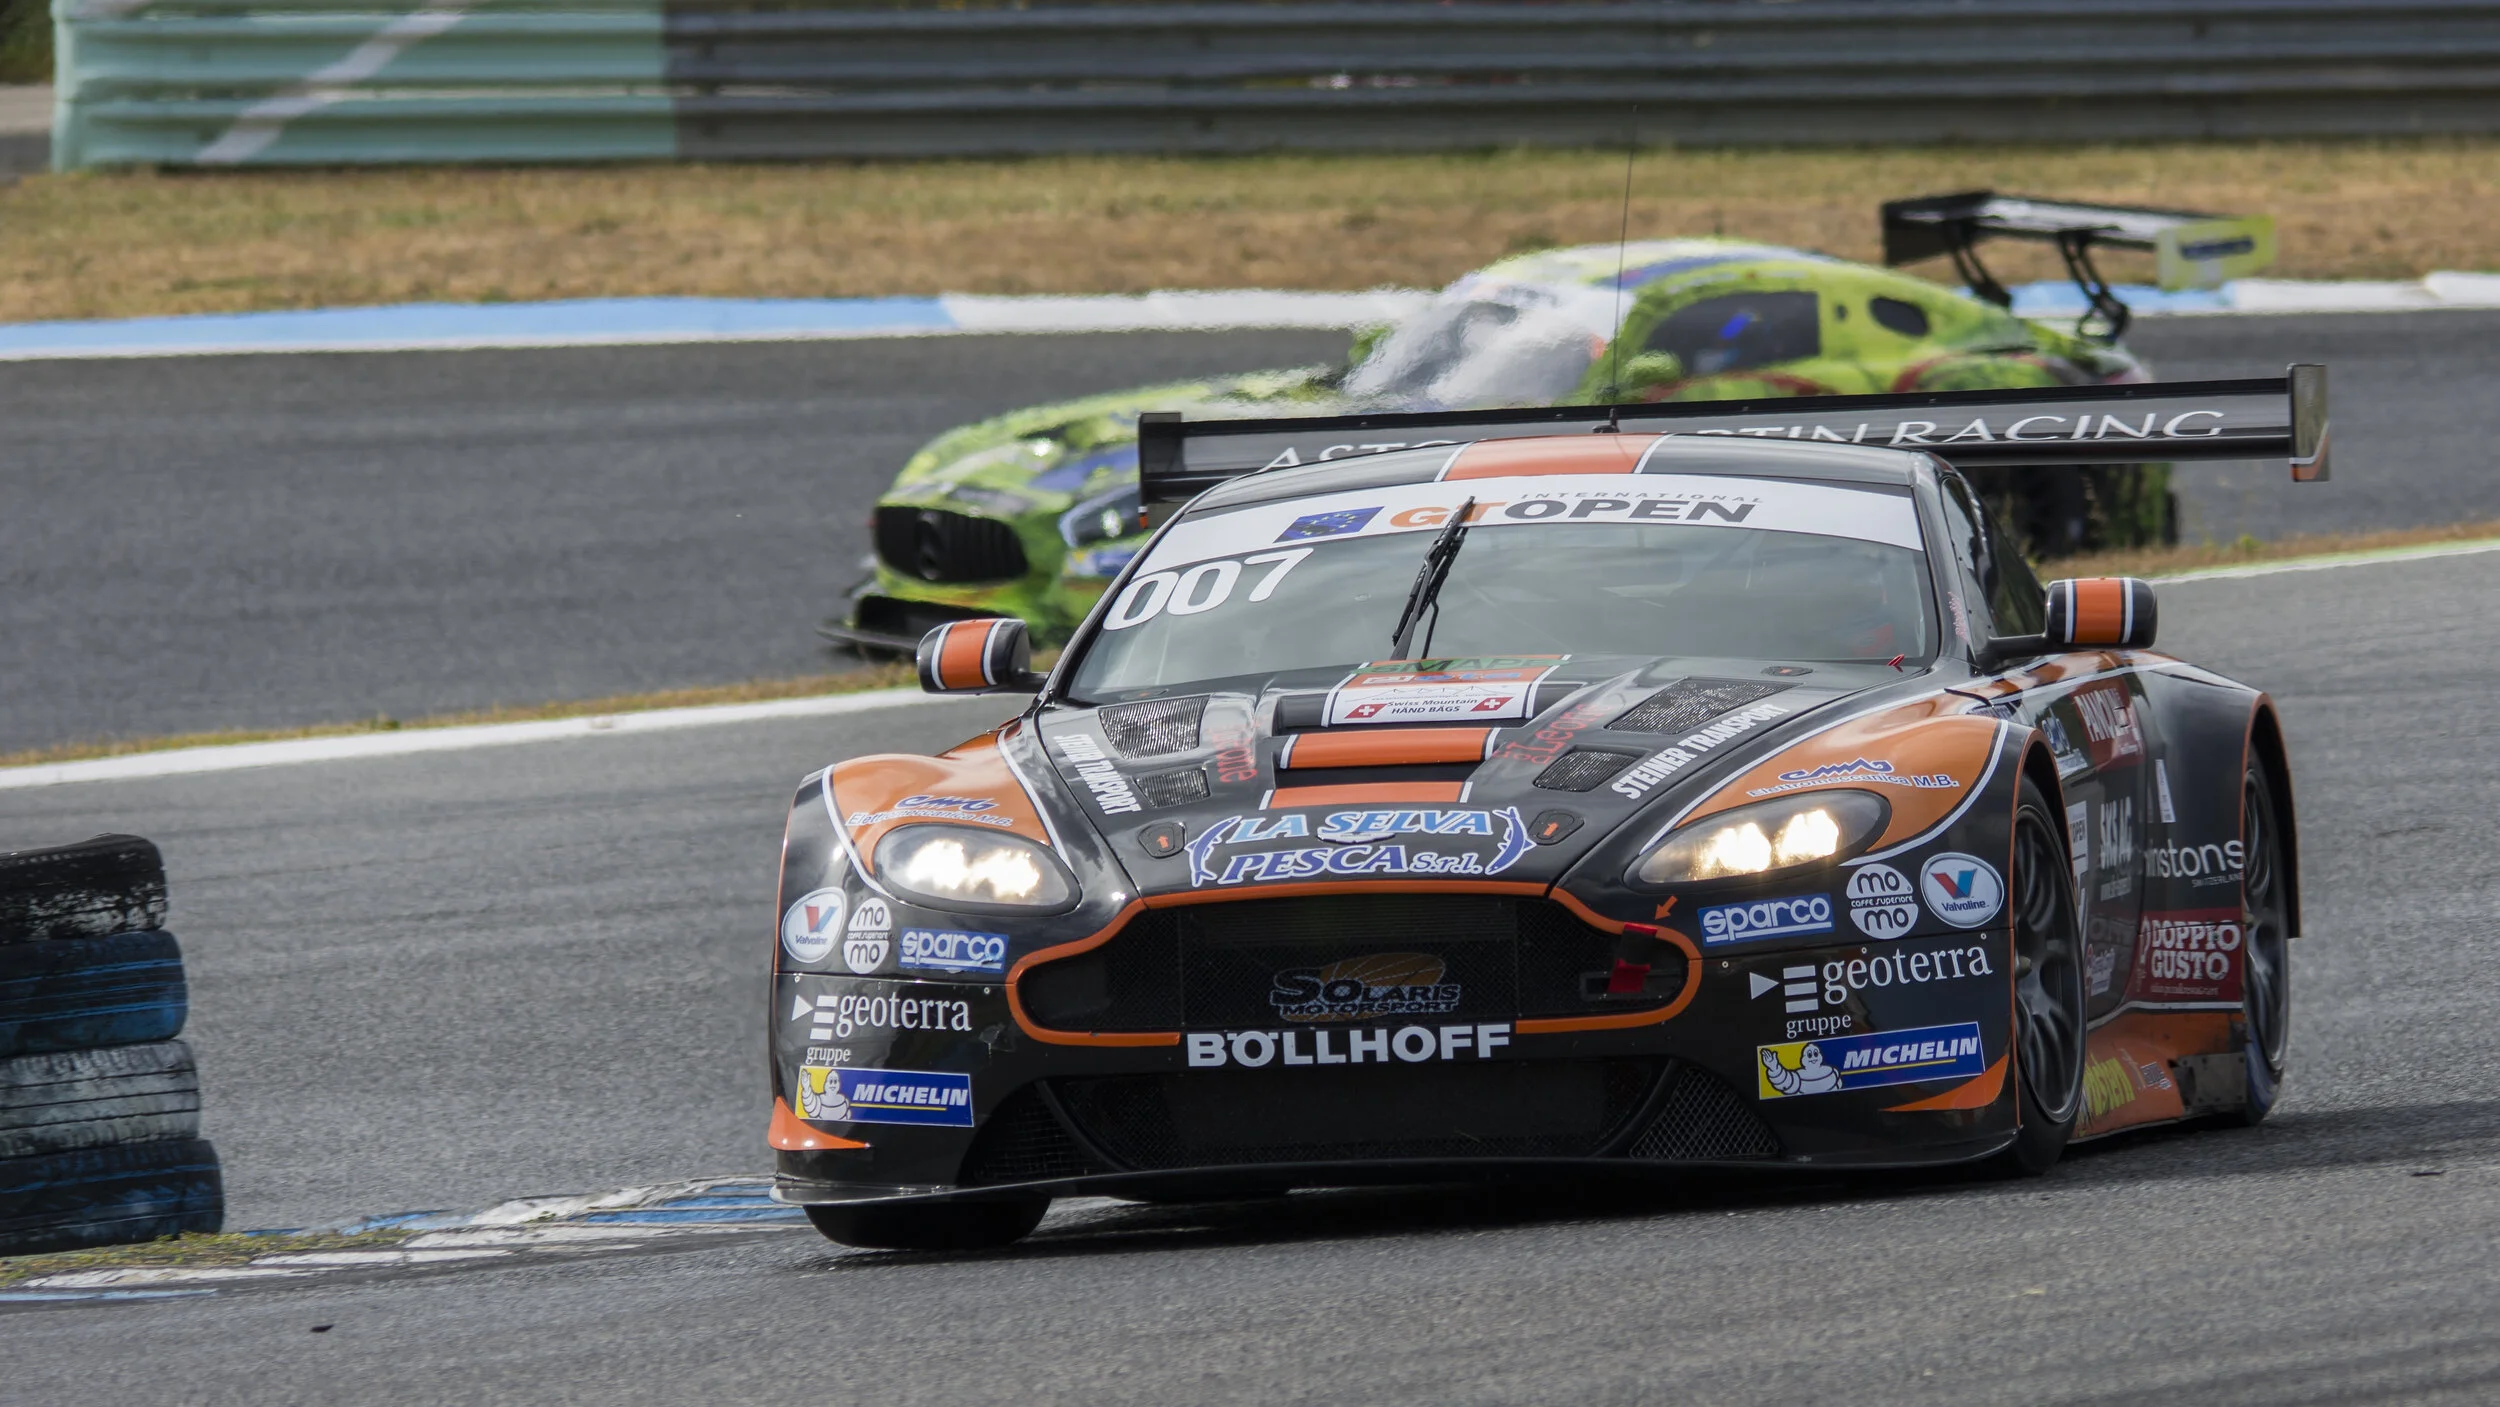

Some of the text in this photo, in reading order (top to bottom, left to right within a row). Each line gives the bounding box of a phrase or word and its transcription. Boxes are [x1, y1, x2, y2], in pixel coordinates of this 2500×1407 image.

[1888, 410, 2225, 445] RACING
[1520, 491, 1764, 504] INTERNATIONAL
[1102, 546, 1314, 631] 007
[1422, 698, 1478, 706] Mountain
[1611, 703, 1790, 800] STEINER TRANSPORT
[1053, 733, 1143, 815] STEINER TRANSPORT
[1746, 772, 1960, 798] Elettromeccanica M.B.
[1225, 810, 1494, 844] LA SELVA
[1217, 844, 1485, 885] PESCA S.r.l.
[1703, 897, 1831, 942] sparco
[1941, 900, 1987, 912] Valvoline
[795, 934, 828, 945] Valvoline
[901, 930, 1005, 965] sparco
[2151, 919, 2242, 951] DOPPIO
[1822, 945, 1994, 1005] geoterra
[2151, 950, 2230, 981] GUSTO
[835, 991, 973, 1038] geoterra
[1280, 1000, 1460, 1017] MOTORSPORT
[1786, 1014, 1852, 1040] gruppe
[805, 1046, 852, 1067] gruppe
[1186, 1024, 1511, 1068] BÖLLHOFF
[1842, 1037, 1979, 1070] MICHELIN
[852, 1083, 969, 1107] MICHELIN
